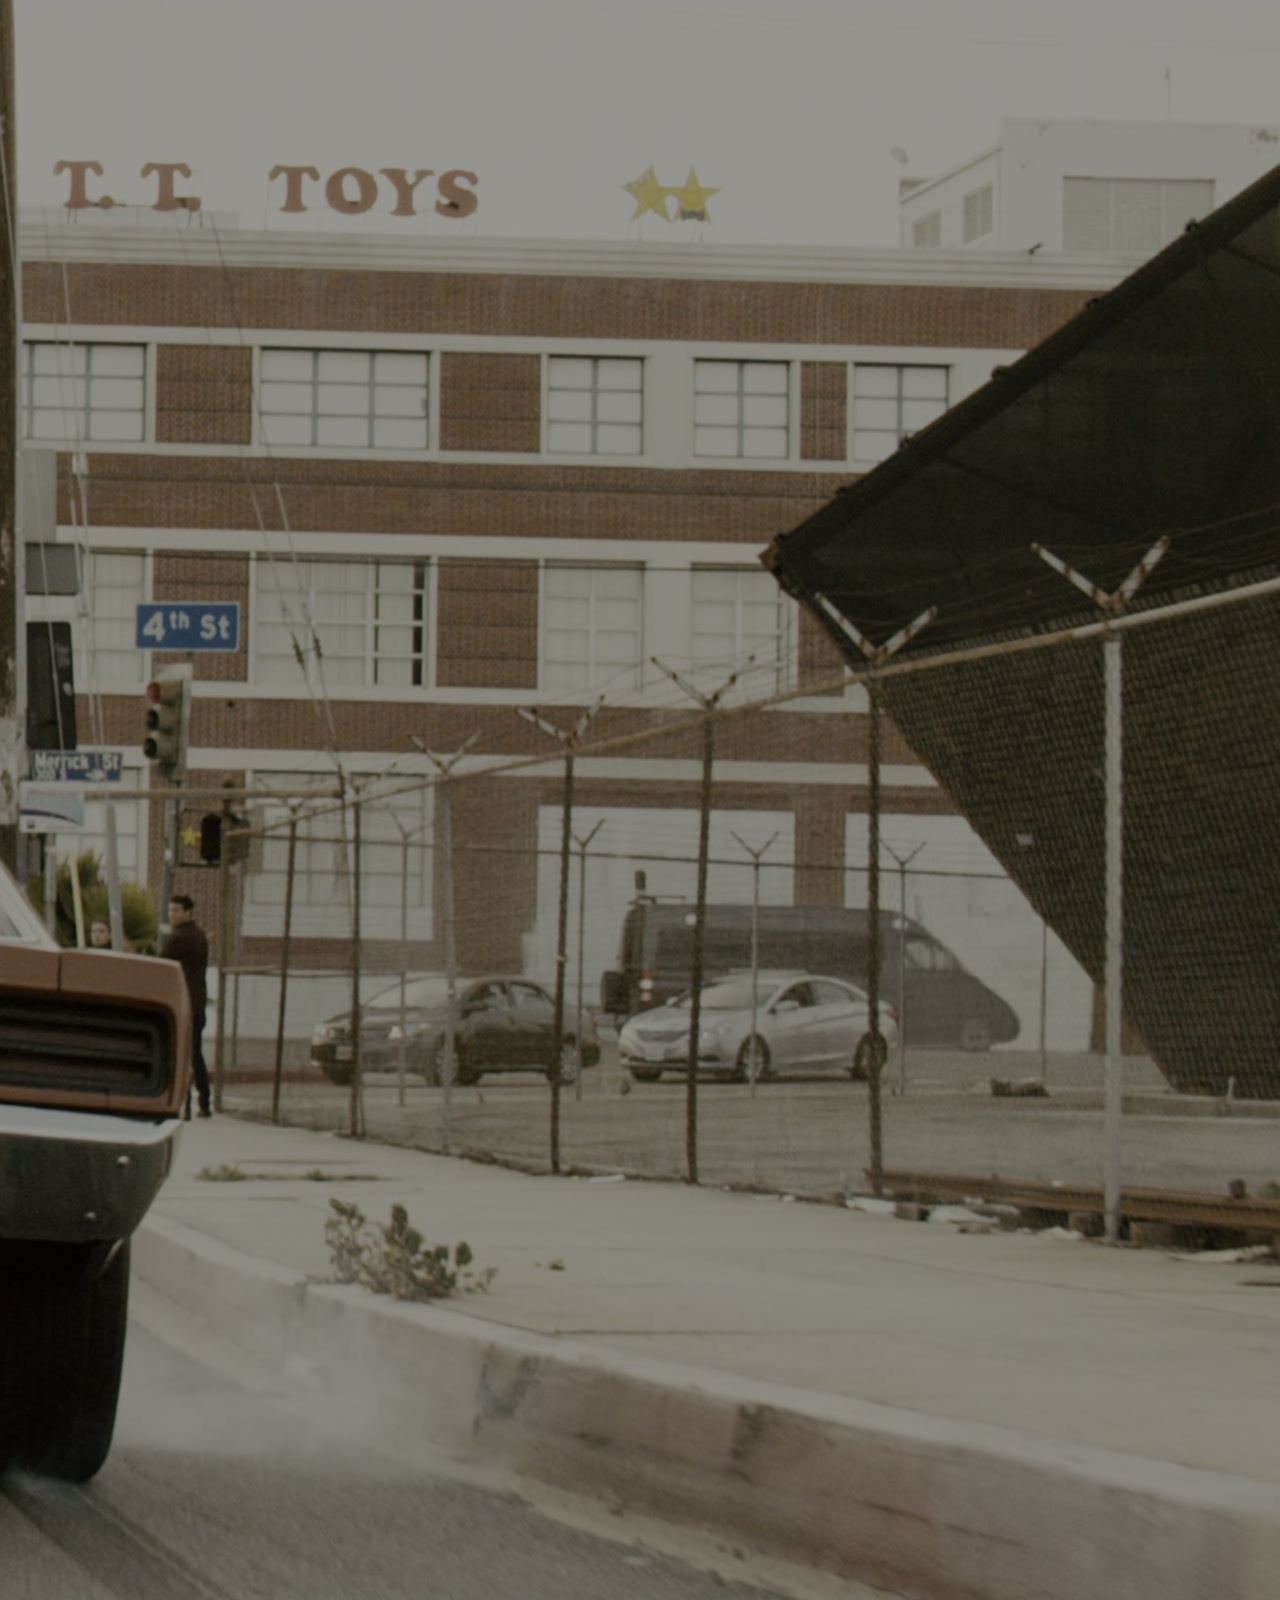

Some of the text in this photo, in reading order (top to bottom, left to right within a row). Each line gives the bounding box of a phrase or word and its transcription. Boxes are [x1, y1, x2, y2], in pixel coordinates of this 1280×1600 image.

[268, 164, 479, 218] TOYS
[142, 610, 231, 642] 4th St
[34, 751, 120, 771] Merrick St
